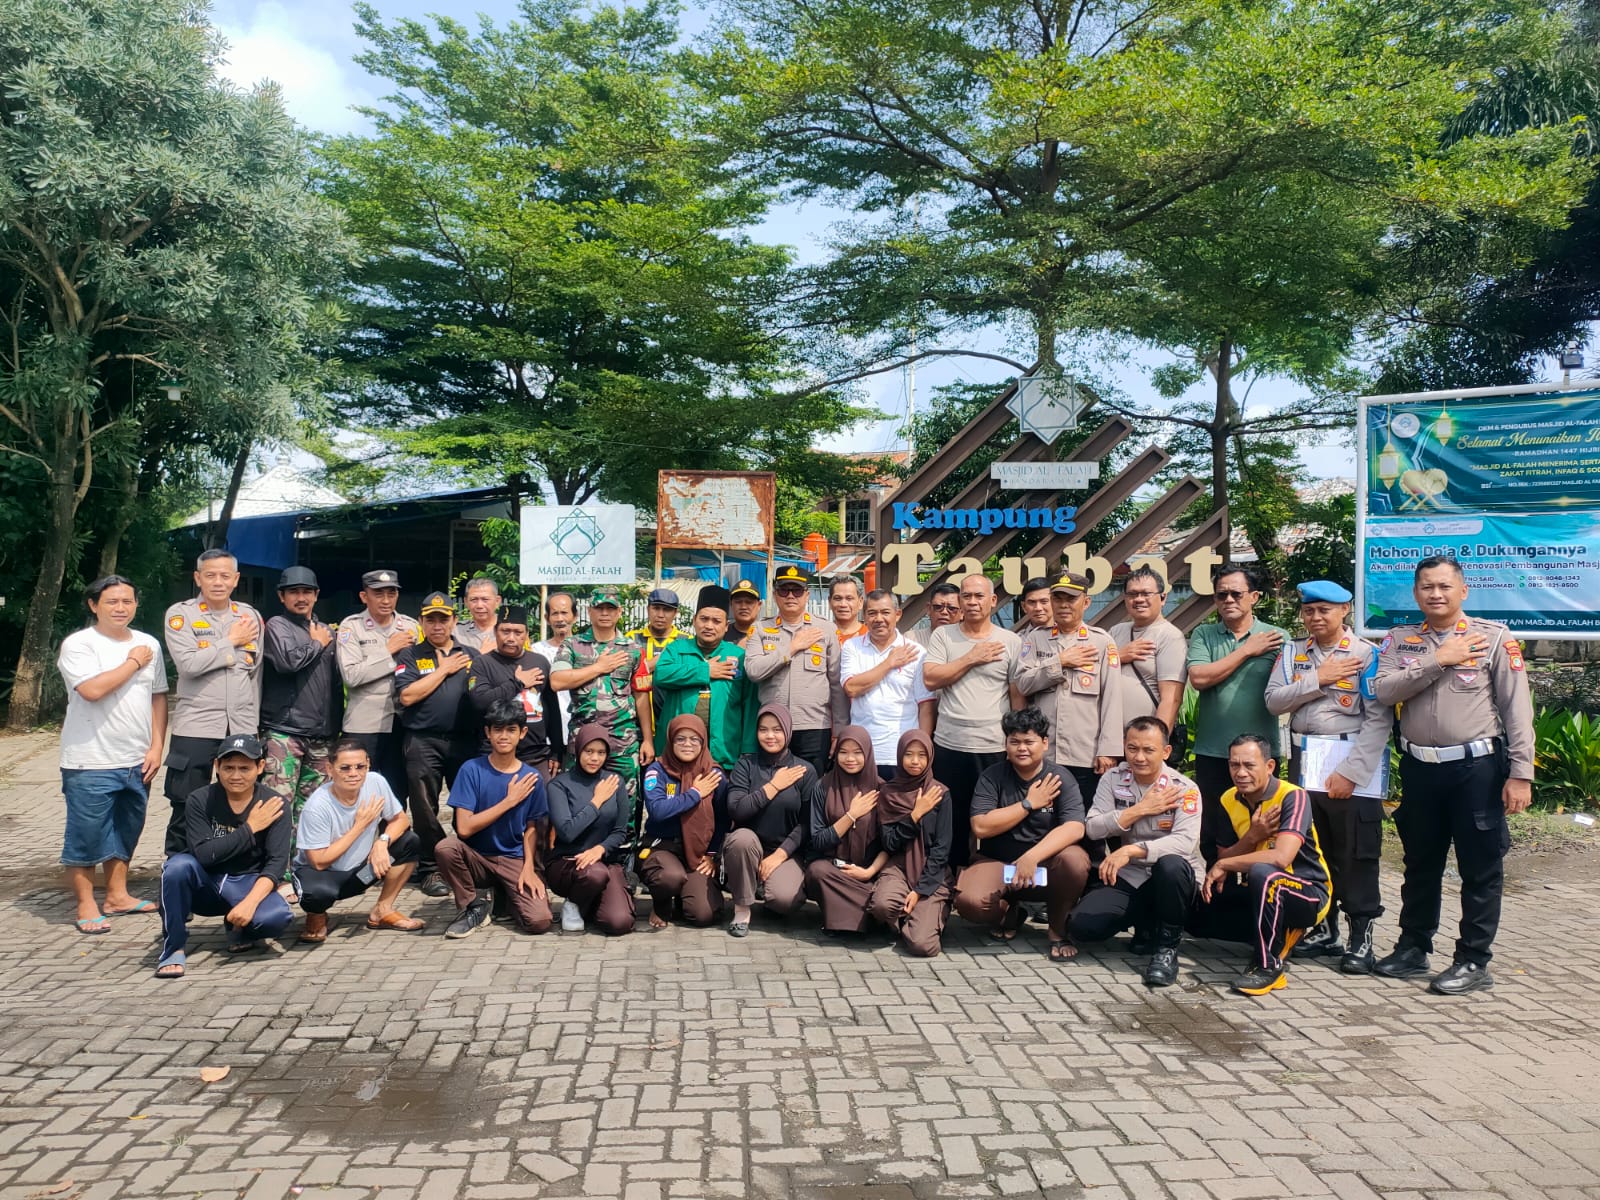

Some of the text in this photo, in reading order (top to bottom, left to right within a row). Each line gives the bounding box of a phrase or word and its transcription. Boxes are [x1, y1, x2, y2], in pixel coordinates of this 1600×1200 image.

[1457, 434, 1504, 449] Selamat
[1505, 431, 1581, 447] Menunaikan
[997, 465, 1033, 477] MASJID
[1555, 467, 1577, 475] INFAQ
[892, 502, 1078, 535] Kampung
[1370, 546, 1419, 558] Mohon
[1460, 544, 1472, 557] &
[1476, 544, 1587, 559] Dukungannya
[538, 566, 573, 576] MASJID
[882, 542, 1224, 597] Taubat
[1370, 563, 1392, 571] Akan
[1461, 561, 1503, 570] Renovasi
[1505, 561, 1575, 570] Pembangunan
[1568, 619, 1593, 627] FALAH
